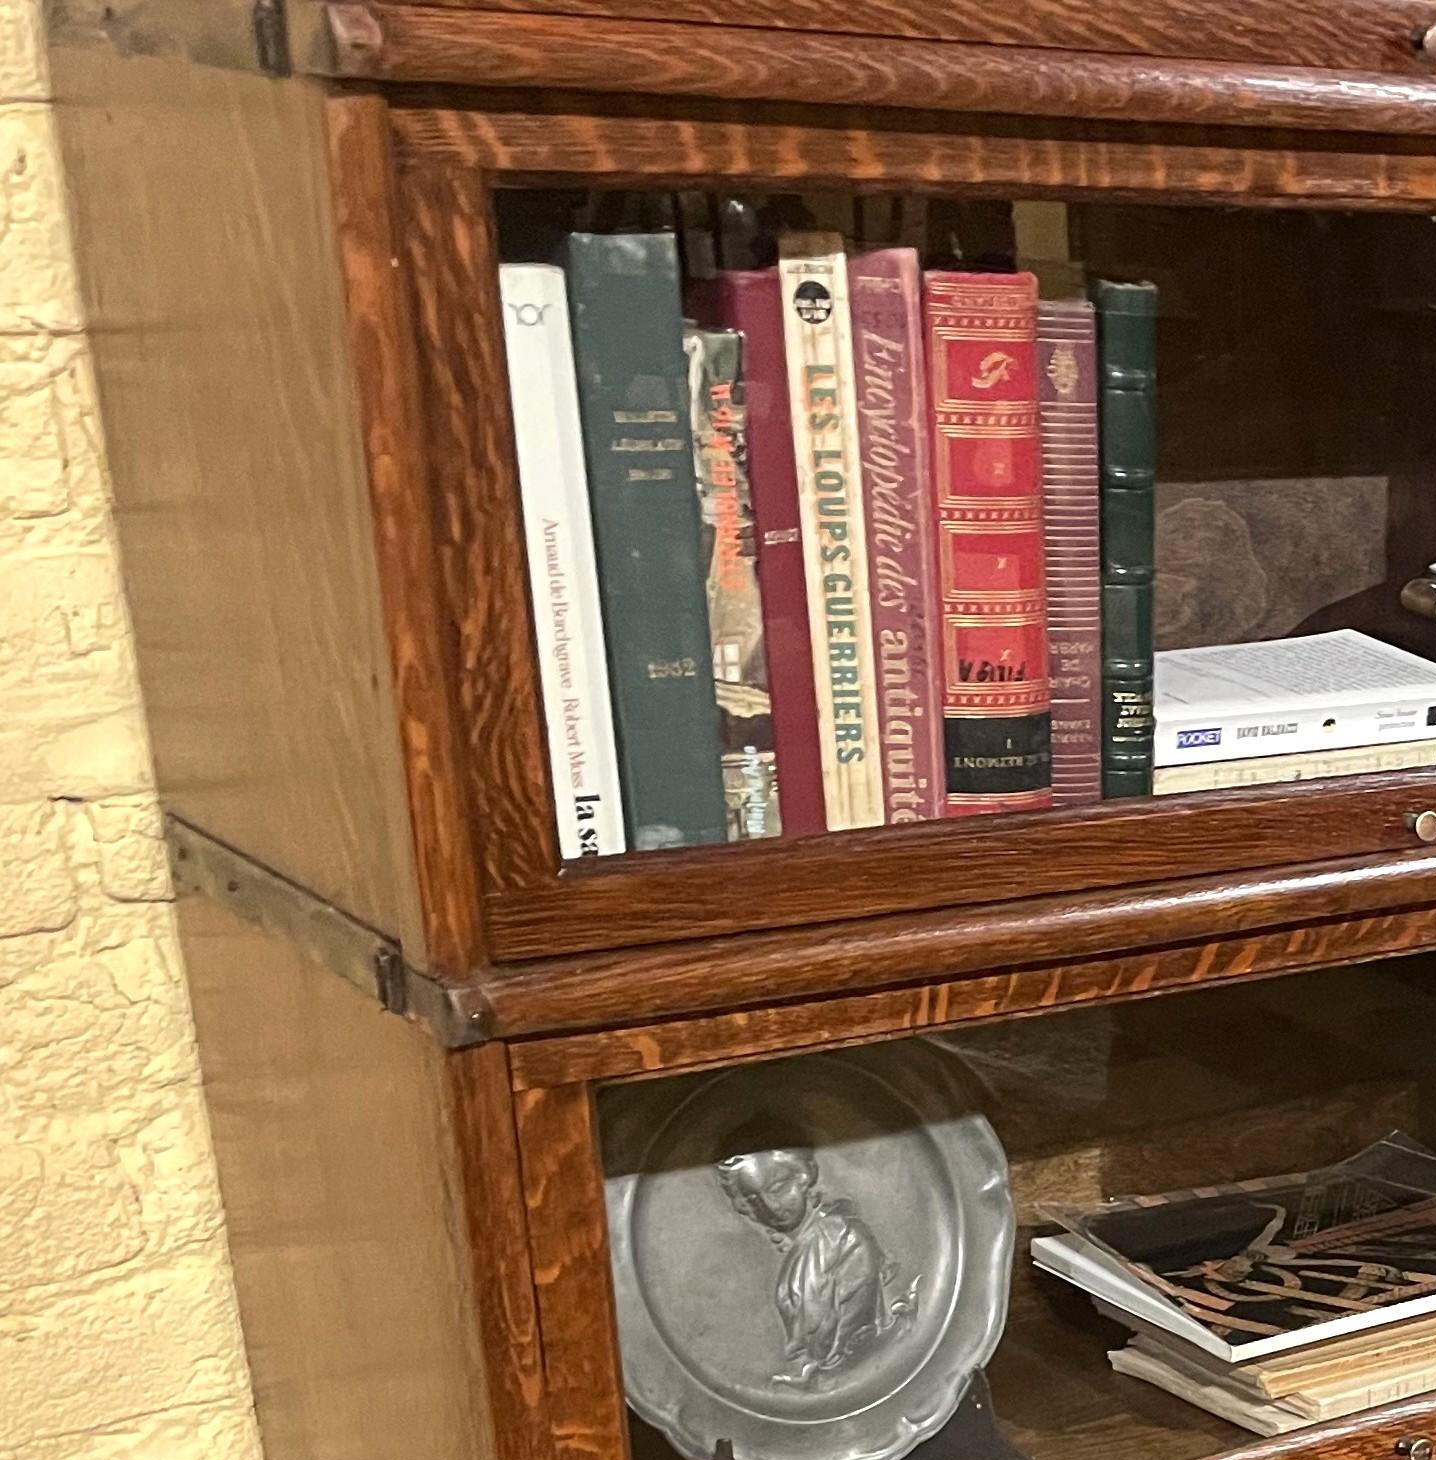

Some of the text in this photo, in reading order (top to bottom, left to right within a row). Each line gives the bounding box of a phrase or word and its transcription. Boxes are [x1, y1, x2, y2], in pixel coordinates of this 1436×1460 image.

[805, 364, 839, 430] LES
[813, 450, 850, 563] LOUPS
[550, 578, 568, 598] de
[823, 574, 864, 764] GUERRIERS
[562, 698, 586, 789] Robert Moss
[1177, 730, 1221, 747] POCKET
[574, 794, 601, 820] la
